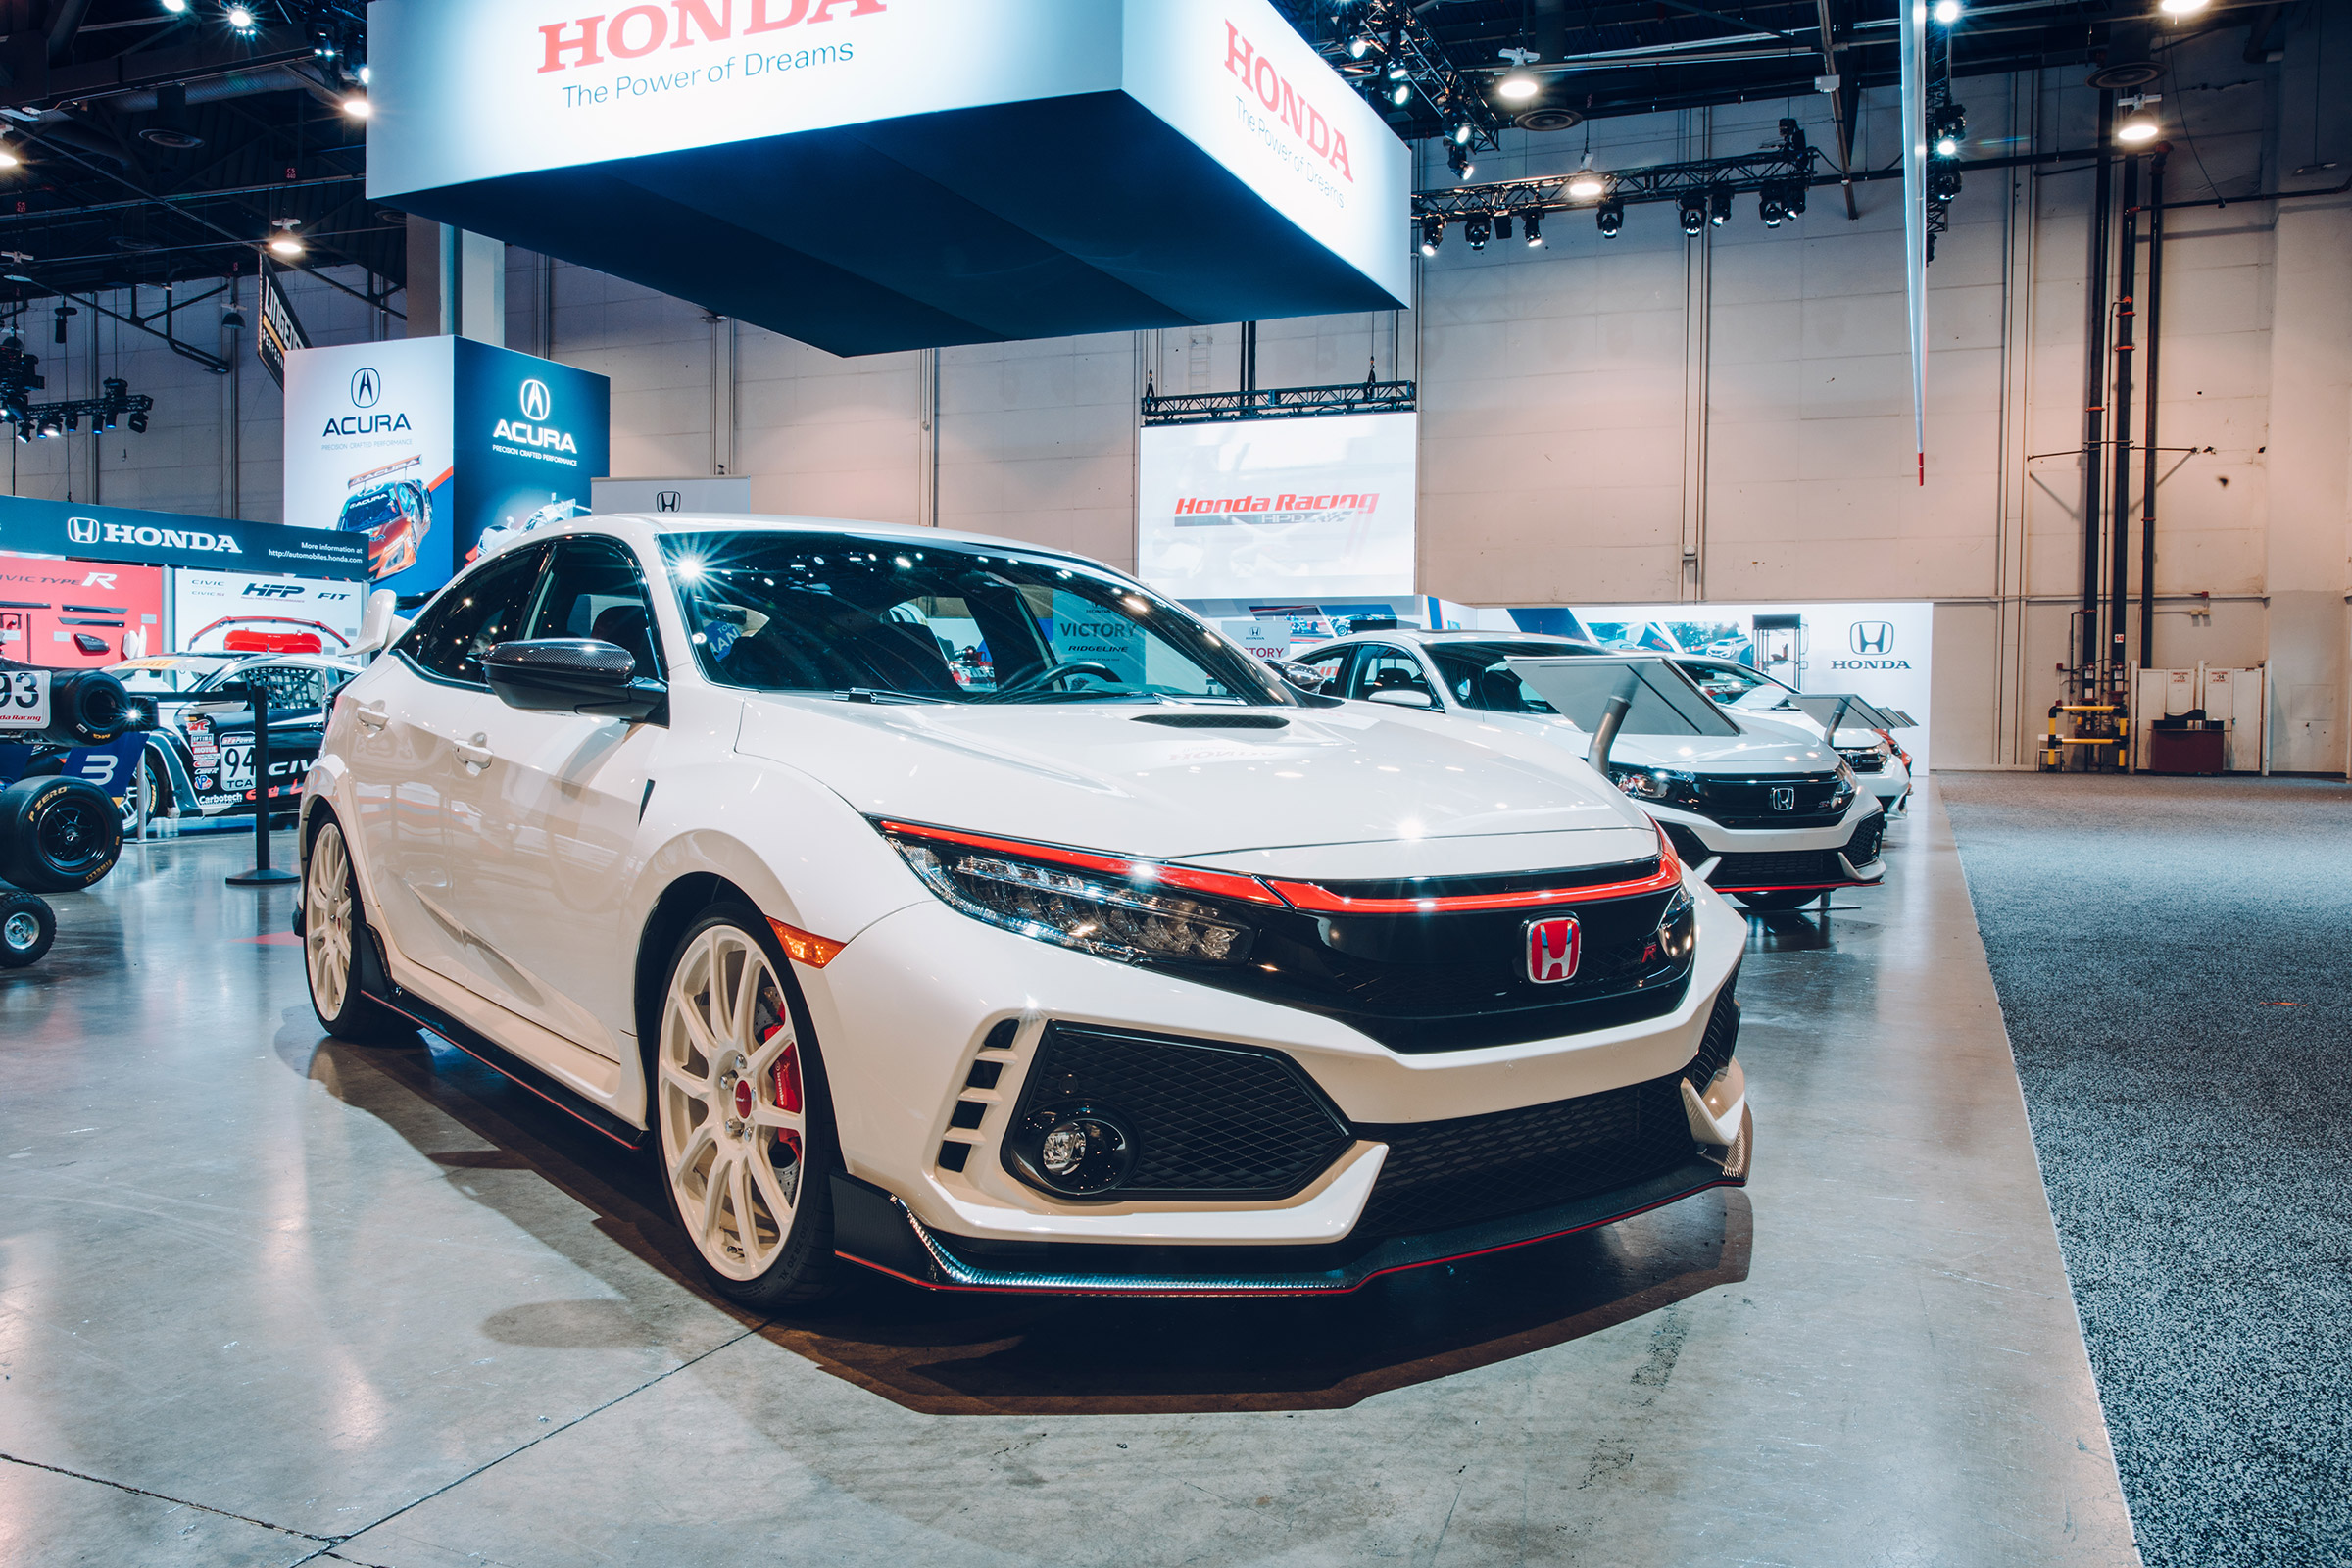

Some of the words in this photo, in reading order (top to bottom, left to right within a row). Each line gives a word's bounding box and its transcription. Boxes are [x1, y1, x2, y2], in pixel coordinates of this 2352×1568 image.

[562, 84, 608, 109] The
[616, 68, 702, 99] Power
[707, 56, 736, 83] of
[745, 42, 855, 76] Dreams
[1224, 18, 1354, 184] HONDA
[1235, 95, 1256, 132] The
[1258, 117, 1293, 161] Power
[1293, 154, 1305, 173] of
[1306, 161, 1345, 209] Dreams
[321, 413, 412, 437] ACURA
[373, 438, 413, 448] PERFORMANCE
[492, 418, 578, 455] ACURA
[492, 444, 519, 456] PRECISION
[519, 449, 542, 460] CRAFTED
[542, 454, 578, 467] PERFORMANCE
[356, 493, 388, 508] ACURA
[1174, 494, 1271, 514] Honda
[1274, 492, 1381, 514] Racing
[1261, 514, 1305, 524] HPD
[103, 523, 243, 554] HONDA
[301, 541, 318, 550] More
[319, 543, 355, 553] information
[269, 548, 363, 564] http://automobiles.honda.com
[40, 576, 80, 586] TYPE
[81, 571, 118, 590] R
[241, 582, 306, 598] HFP
[317, 592, 352, 601] FIT
[1059, 622, 1138, 638] VICTORY
[1830, 660, 1912, 670] HONDA
[224, 746, 256, 778] 94
[226, 779, 253, 788] TCA
[34, 786, 68, 811] ZERO
[198, 792, 243, 804] Carbotech
[1642, 943, 1657, 963] R
